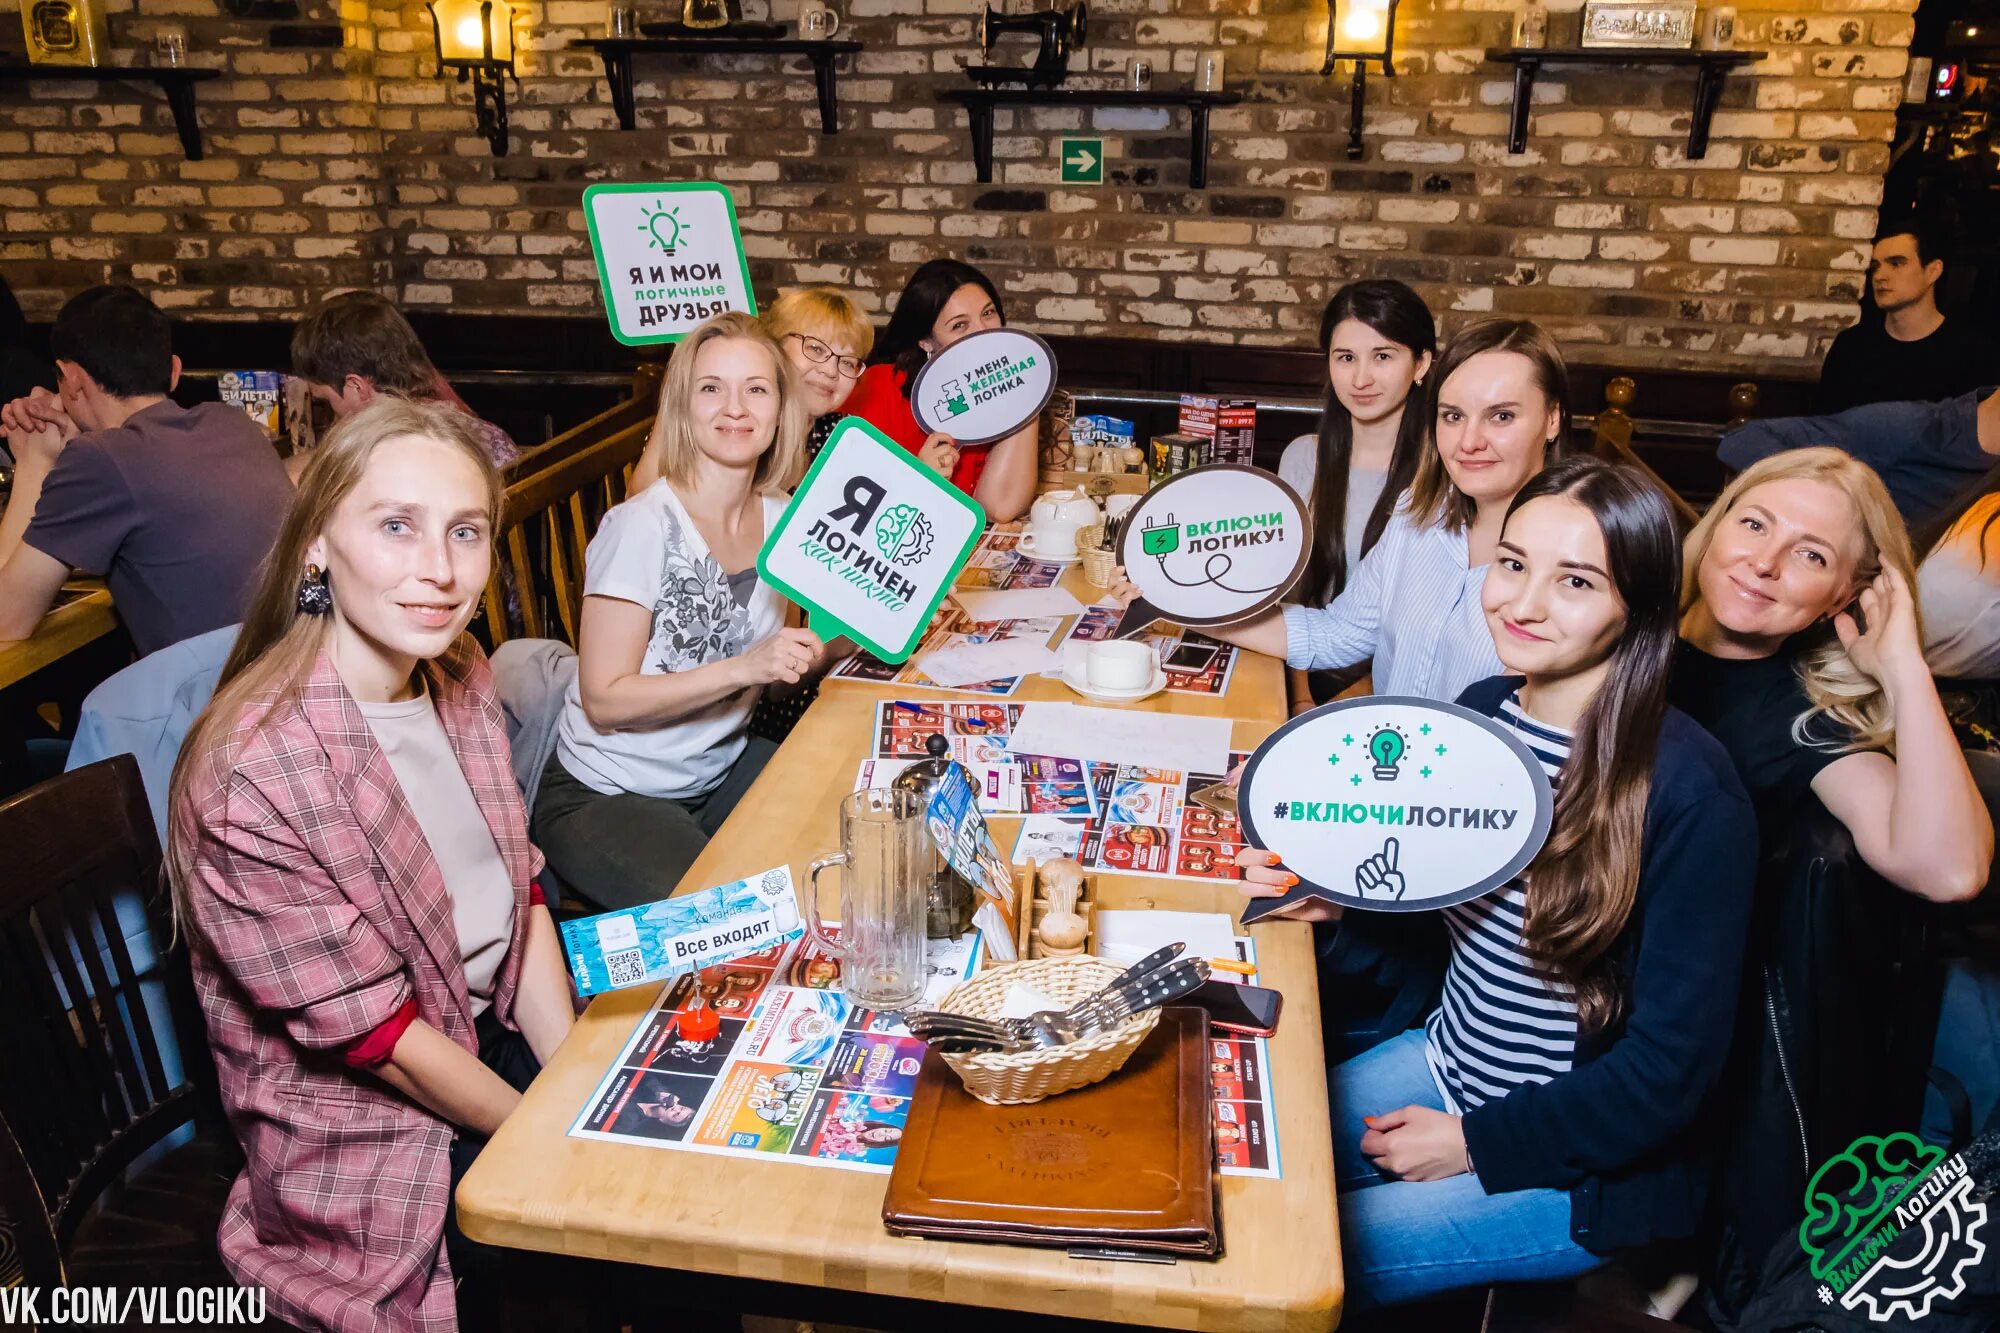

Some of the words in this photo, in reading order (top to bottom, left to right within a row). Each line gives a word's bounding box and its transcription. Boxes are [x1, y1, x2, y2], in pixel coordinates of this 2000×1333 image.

[629, 267, 644, 285] Я
[649, 266, 665, 283] И
[670, 263, 722, 282] МОИ
[635, 285, 726, 301] логичные
[963, 372, 972, 383] У
[974, 355, 1010, 379] МЕНЯ
[968, 356, 1036, 393] ЖЕЛЕЗНАЯ
[222, 390, 278, 402] БИЛЕТЫ
[973, 376, 1025, 406] ЛОГИКА
[1072, 430, 1133, 445] БИЛЕТЫ
[826, 475, 888, 537] Я
[1186, 511, 1283, 538] ВКЛЮЧИ
[1188, 527, 1284, 554] ЛОГИКУ!
[798, 539, 842, 572] как
[838, 566, 907, 612] никто
[807, 519, 918, 603] ЛОГИЧЕН
[1273, 801, 1518, 830] #ВКЛЮЧИЛОГИКУ
[674, 940, 708, 958] Все
[712, 919, 771, 949] входят
[779, 1072, 819, 1127] БИЛЕТЫ
